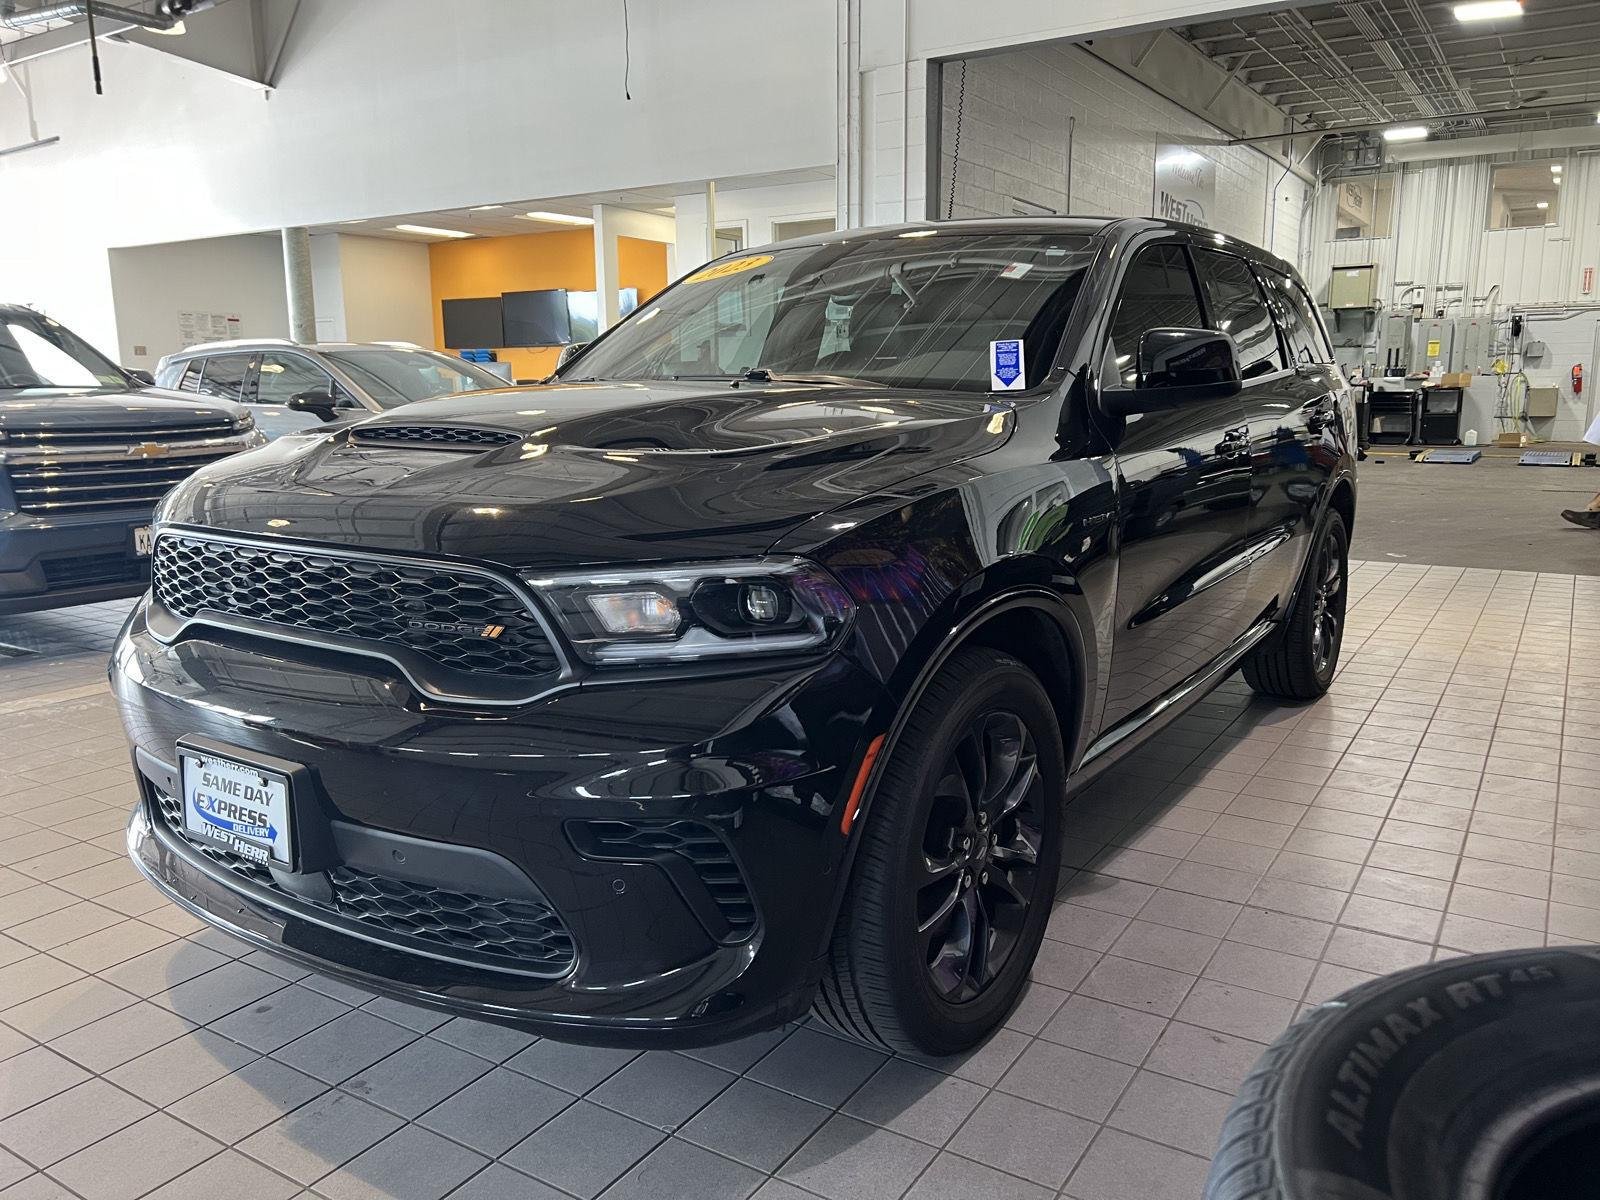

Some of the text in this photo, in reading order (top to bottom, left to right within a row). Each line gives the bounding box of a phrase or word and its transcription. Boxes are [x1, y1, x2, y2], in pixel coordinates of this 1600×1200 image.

[200, 755, 259, 778] westherr.com
[201, 771, 274, 807] SAME DAY
[196, 792, 268, 829] EXPRESS
[232, 823, 270, 838] DELIVERY
[1326, 997, 1442, 1151] ALTIMAX
